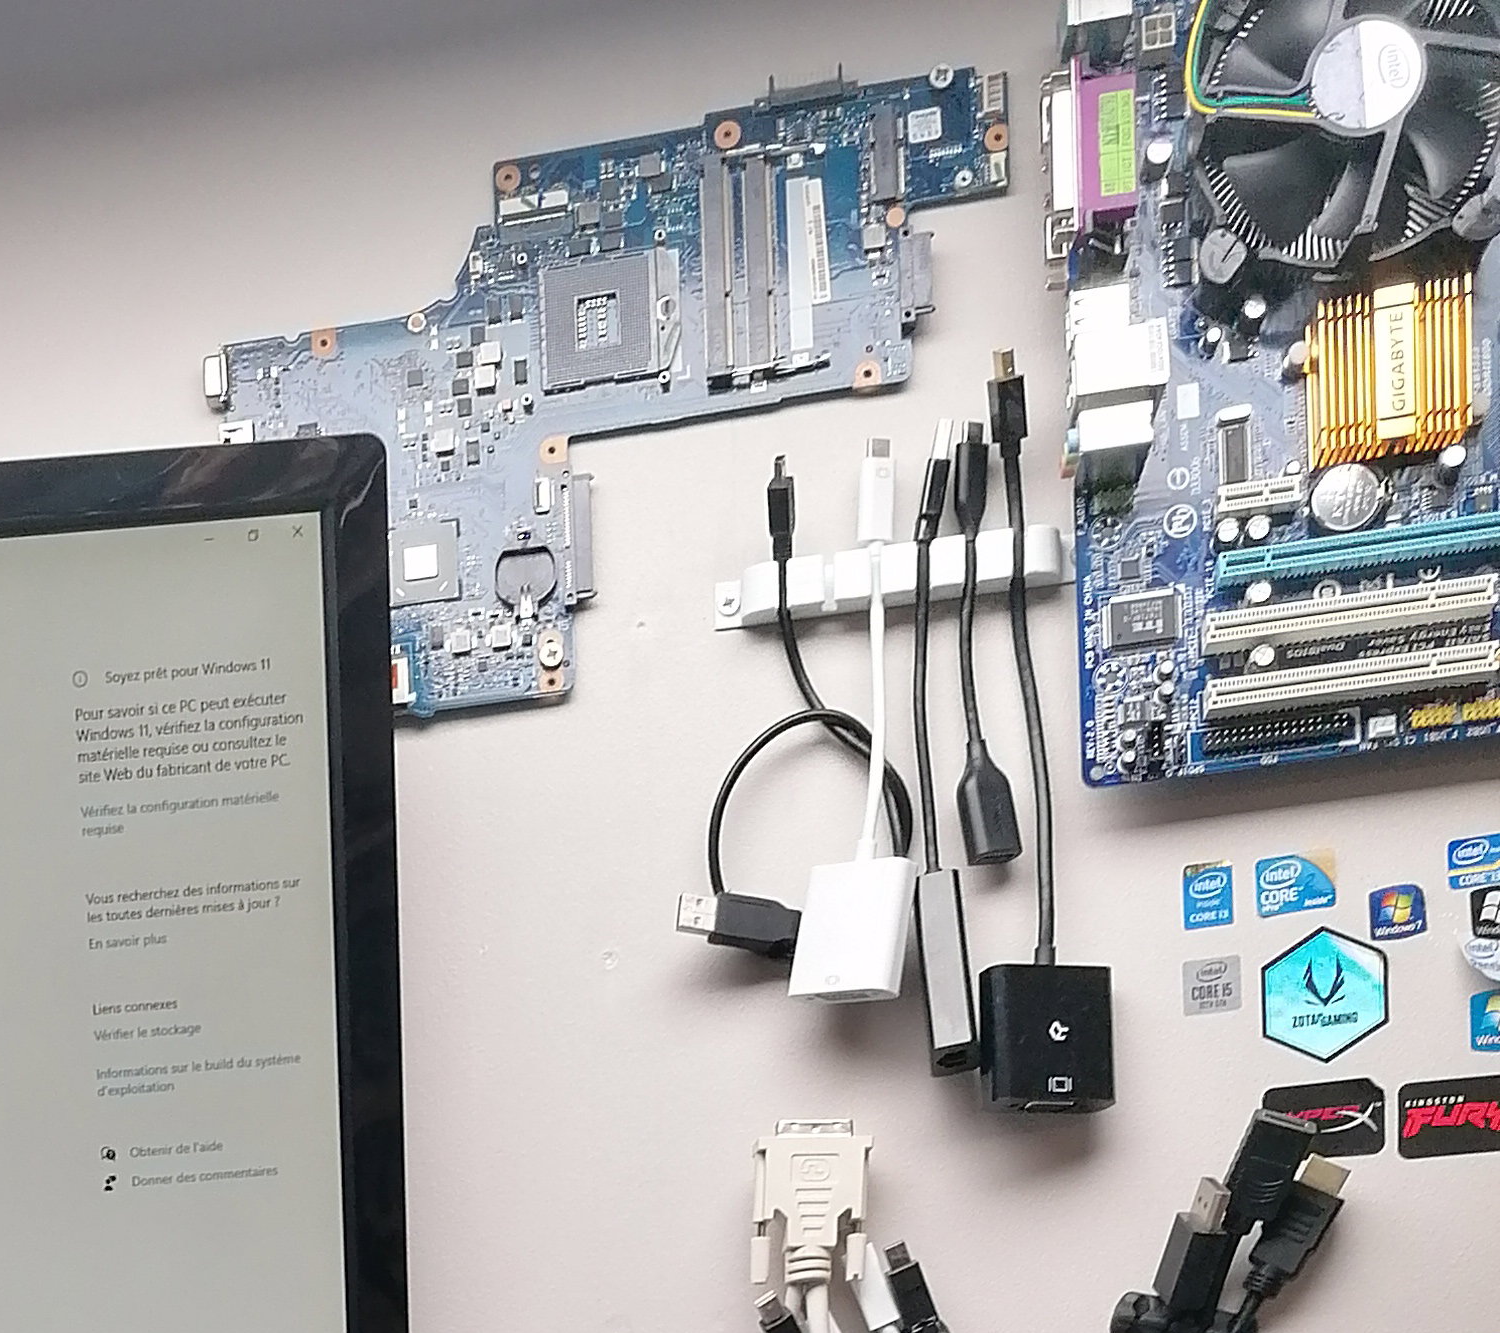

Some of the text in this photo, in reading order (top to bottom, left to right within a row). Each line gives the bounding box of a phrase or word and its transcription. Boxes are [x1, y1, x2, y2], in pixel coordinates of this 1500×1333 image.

[1389, 311, 1407, 412] GIGABYTE
[104, 657, 272, 686] Soyez prêt pour Windows 11
[74, 707, 105, 722] Pour
[107, 704, 145, 720] savoir
[161, 704, 177, 716] ce
[179, 699, 198, 713] PC
[200, 697, 230, 714] peut
[232, 693, 288, 710] exécuter
[75, 726, 135, 743] Windows
[138, 725, 153, 740] 11,
[155, 721, 201, 738] vérifiez
[218, 712, 305, 732] configuration
[77, 747, 140, 764] matérielle
[143, 744, 189, 760] requise
[191, 742, 209, 754] ou
[212, 735, 273, 753] consultez
[78, 753, 292, 785] site Web du fabricant de votre PC.
[1193, 875, 1222, 893] intel
[1264, 864, 1297, 884] intel
[1260, 886, 1300, 905] CORE
[1189, 909, 1217, 924] CORE
[88, 933, 168, 950] En savoir plus
[1191, 983, 1220, 1001] CORE
[1403, 1094, 1466, 1109] KINGSTON
